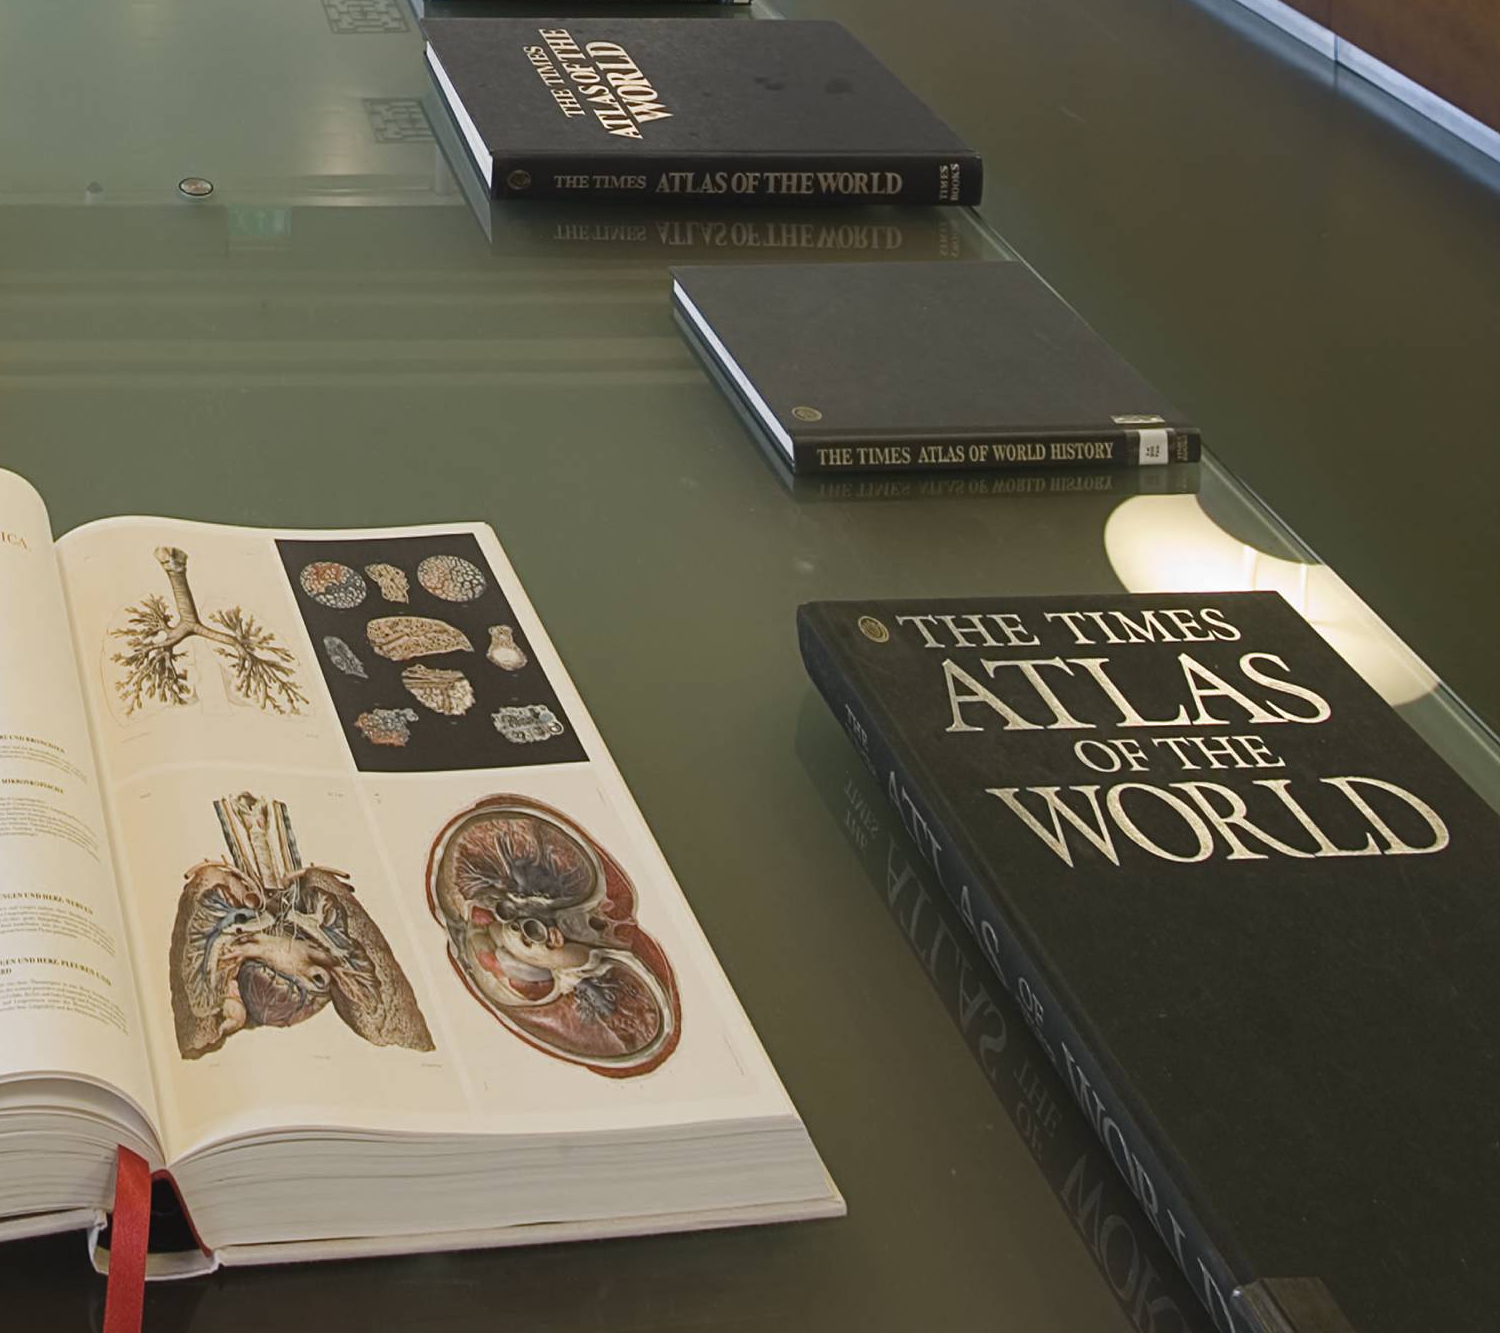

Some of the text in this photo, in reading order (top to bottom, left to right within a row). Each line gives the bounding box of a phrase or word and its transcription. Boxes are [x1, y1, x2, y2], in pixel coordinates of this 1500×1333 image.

[523, 46, 585, 118] THE TIMES
[538, 28, 644, 140] ATLAS OF THE
[586, 40, 674, 124] WORLD
[554, 172, 903, 195] THE TIMES ATLAS OF THE WORLD
[938, 165, 948, 201] TIMES
[948, 163, 960, 202] BOOKS
[816, 441, 1114, 466] THE TIMES ATLAS OF WORLD HISTORY
[894, 609, 1243, 649] THE TIMES
[941, 651, 1332, 733] ATLAS
[1072, 735, 1286, 774] OF THE
[984, 775, 1452, 868] WORLD
